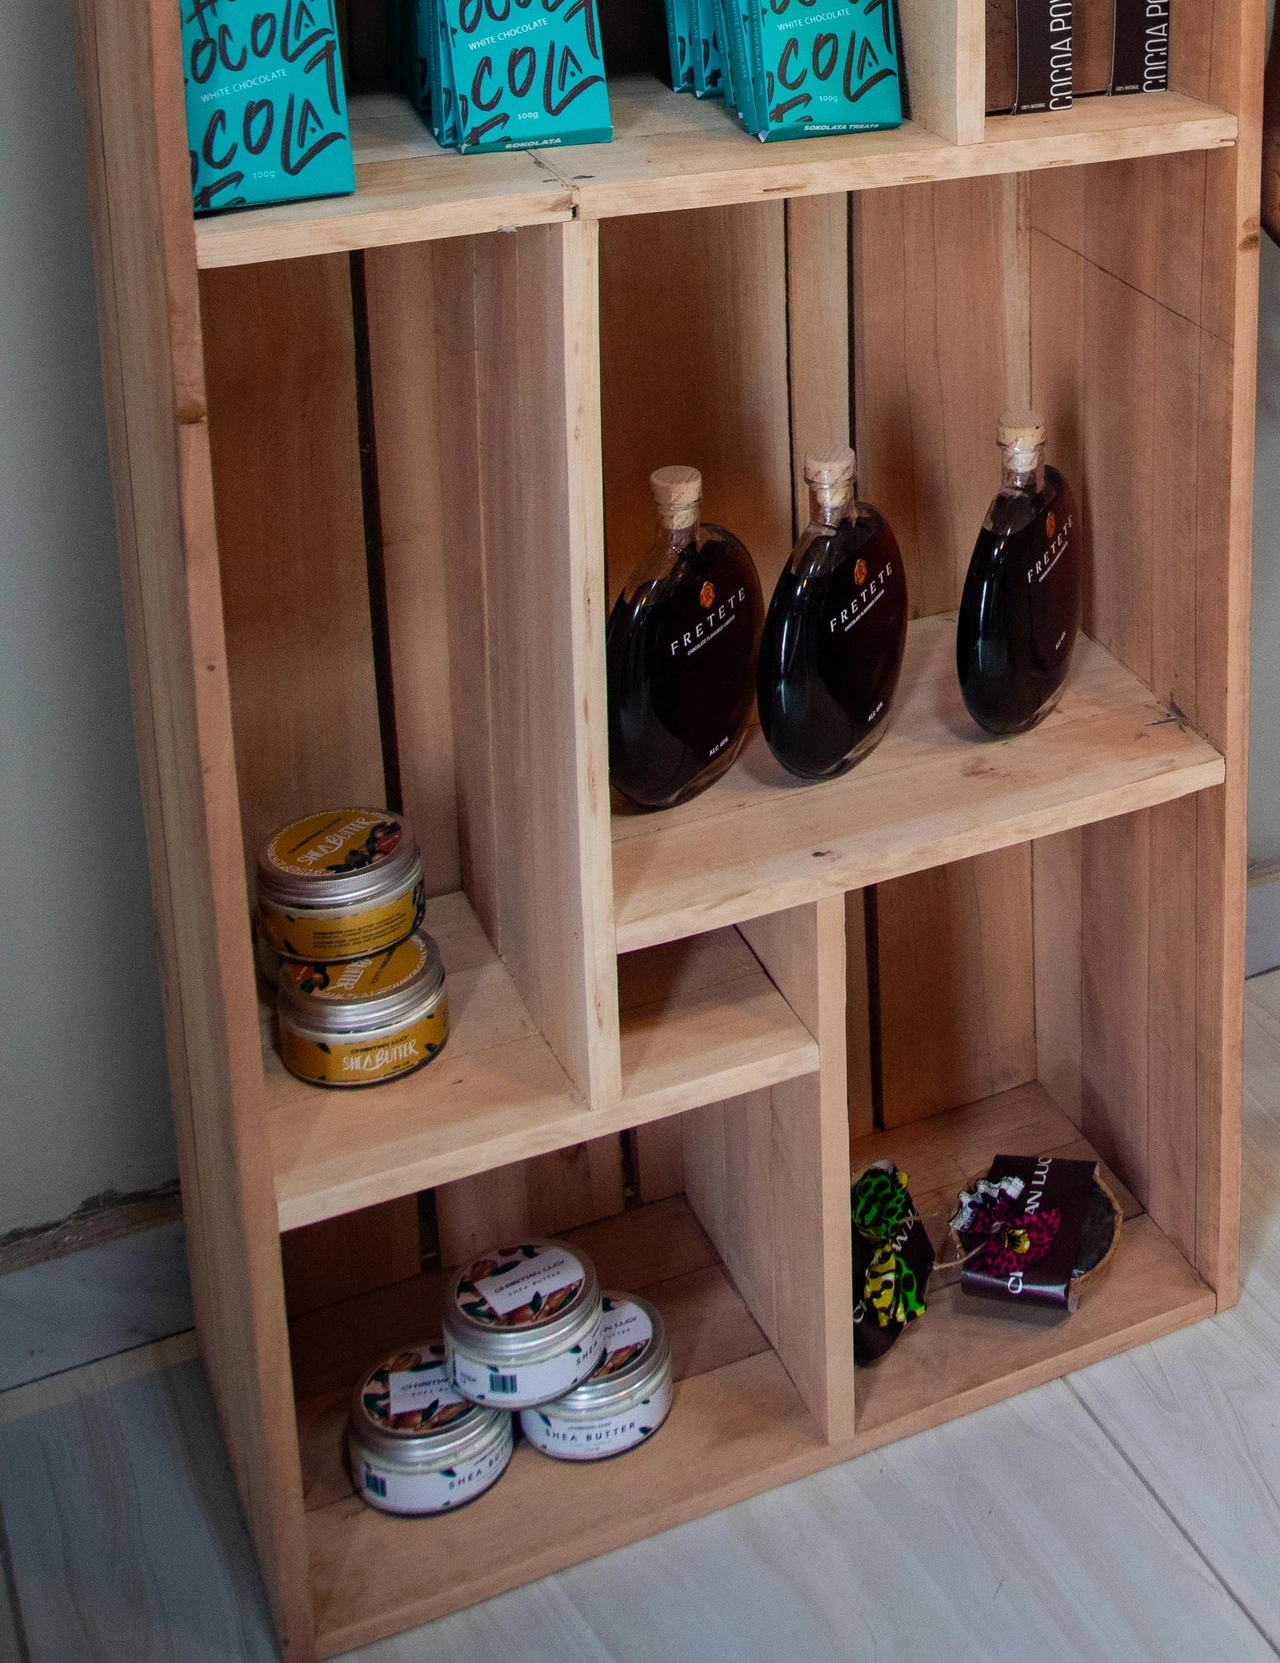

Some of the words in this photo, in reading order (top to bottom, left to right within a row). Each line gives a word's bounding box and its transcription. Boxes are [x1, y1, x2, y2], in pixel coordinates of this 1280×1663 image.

[467, 36, 496, 51] WHITE
[497, 17, 549, 42] CHOCOLATE
[777, 18, 803, 32] WHITE
[804, 7, 851, 25] CHOCOLATE
[1049, 37, 1072, 111] COCOA
[1143, 22, 1168, 93] COCOA
[200, 86, 230, 103] WHITE
[232, 68, 288, 93] CHOCOLATE
[819, 95, 838, 103] 100g
[517, 111, 539, 120] 100g
[505, 138, 563, 149] SOKOLATA
[252, 170, 276, 180] 100g
[1027, 514, 1074, 583] FRETETE
[830, 562, 892, 633] FRETETE
[671, 587, 745, 655] FRETETE
[343, 1051, 371, 1071] SHEA
[371, 1039, 419, 1070] BUTTER
[545, 1428, 577, 1442] SHEA
[586, 1421, 635, 1442] BUTTER
